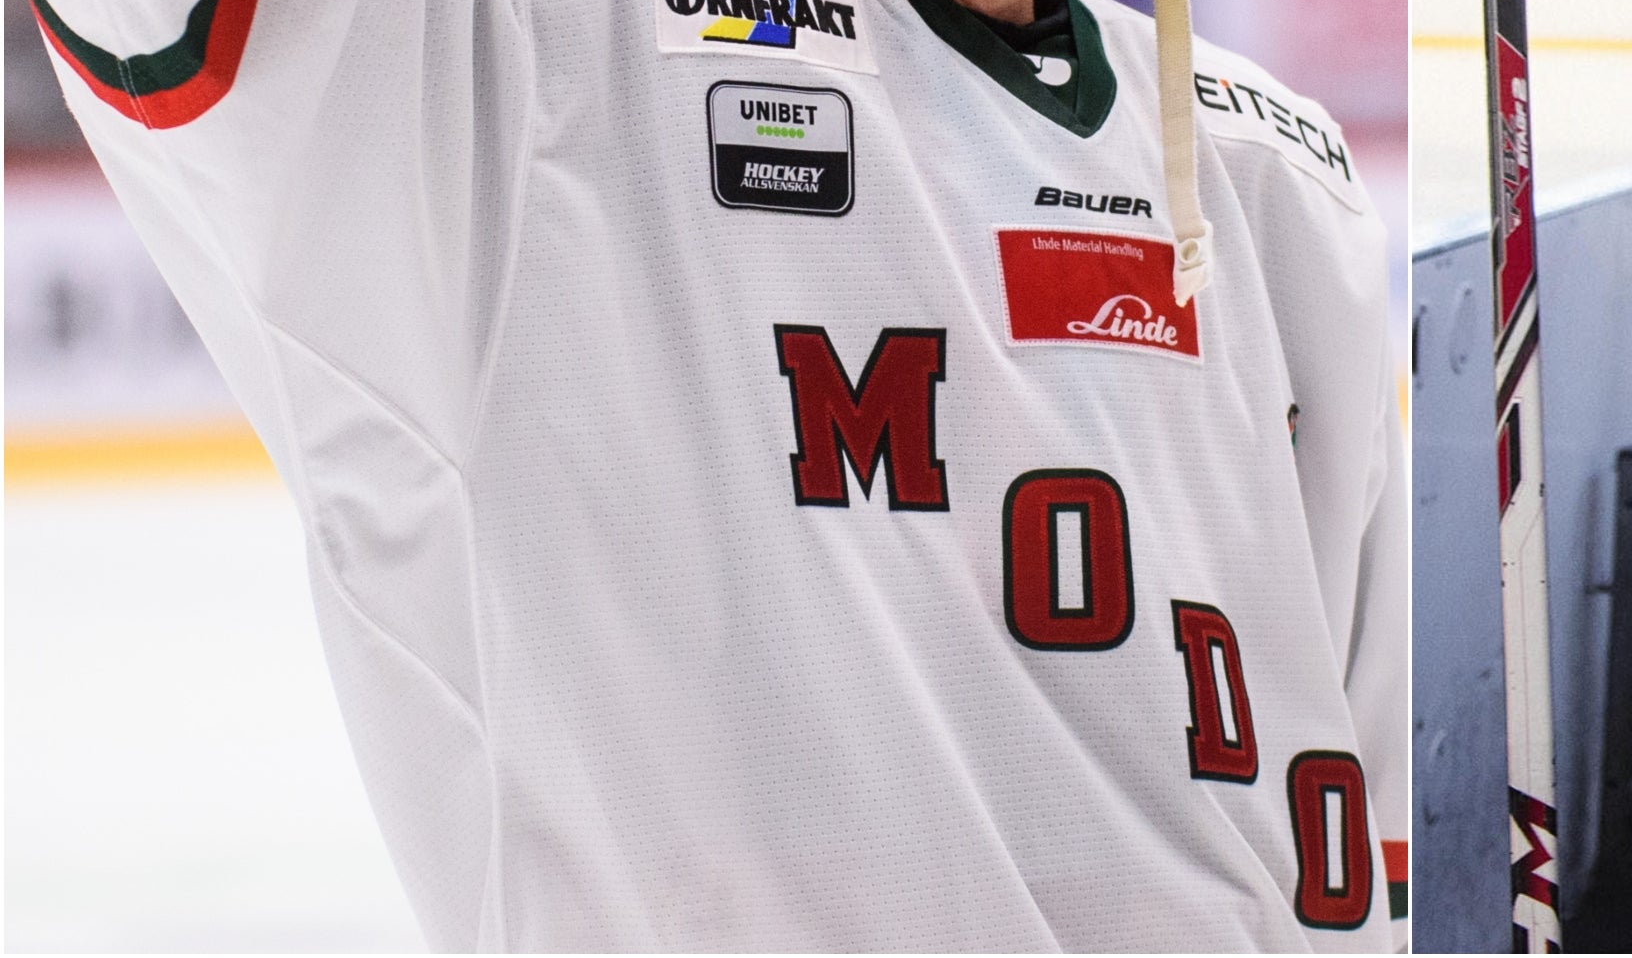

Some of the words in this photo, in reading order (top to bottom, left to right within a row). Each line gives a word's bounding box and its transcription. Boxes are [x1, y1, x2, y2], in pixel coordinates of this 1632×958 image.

[740, 100, 817, 125] UNIBET
[744, 162, 825, 183] HOCKEY
[740, 179, 820, 193] ALLSVENSKAN
[1034, 186, 1153, 218] BAUER
[1032, 238, 1061, 251] Linde
[1062, 239, 1102, 254] Material
[1104, 242, 1144, 261] Handling
[1066, 294, 1178, 346] Linde
[774, 323, 1373, 930] MODO
